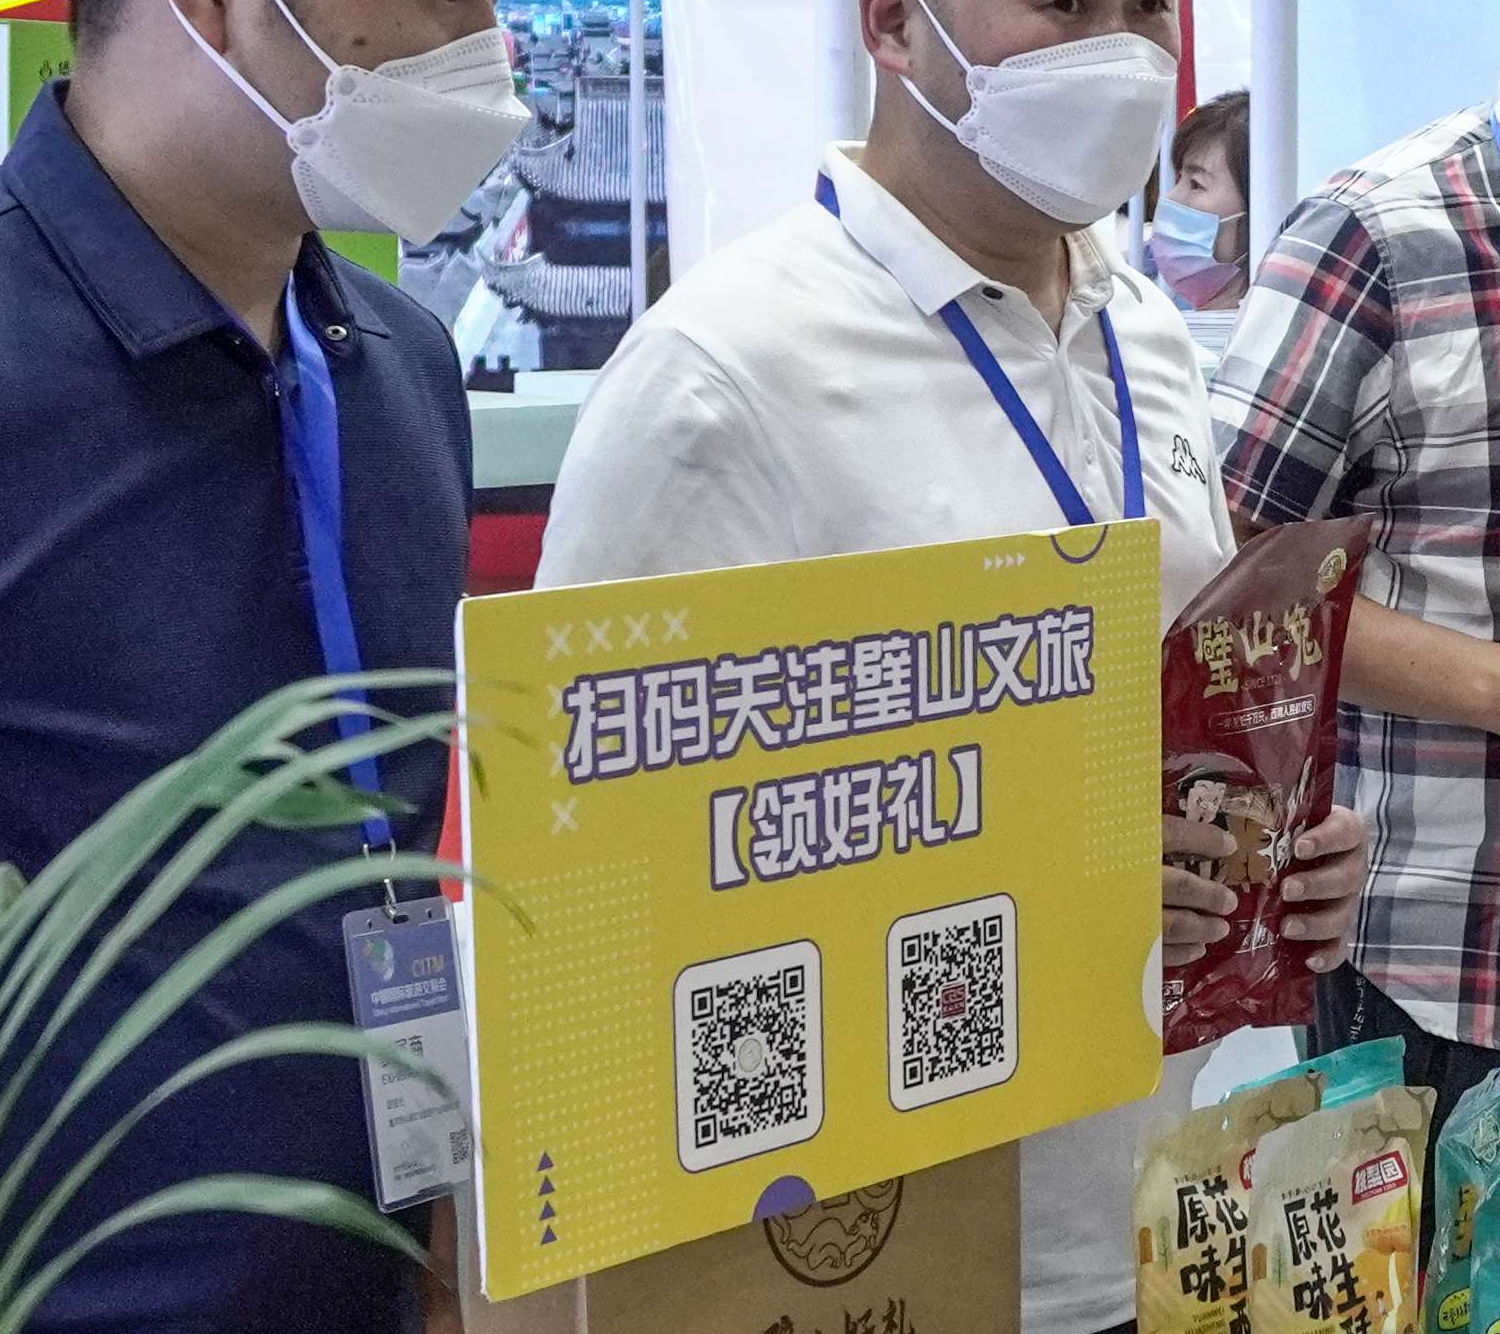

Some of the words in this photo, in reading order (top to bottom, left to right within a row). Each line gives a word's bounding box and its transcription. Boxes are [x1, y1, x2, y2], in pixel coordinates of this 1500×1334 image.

[563, 605, 1097, 785] 扫码关注璧山文旅
